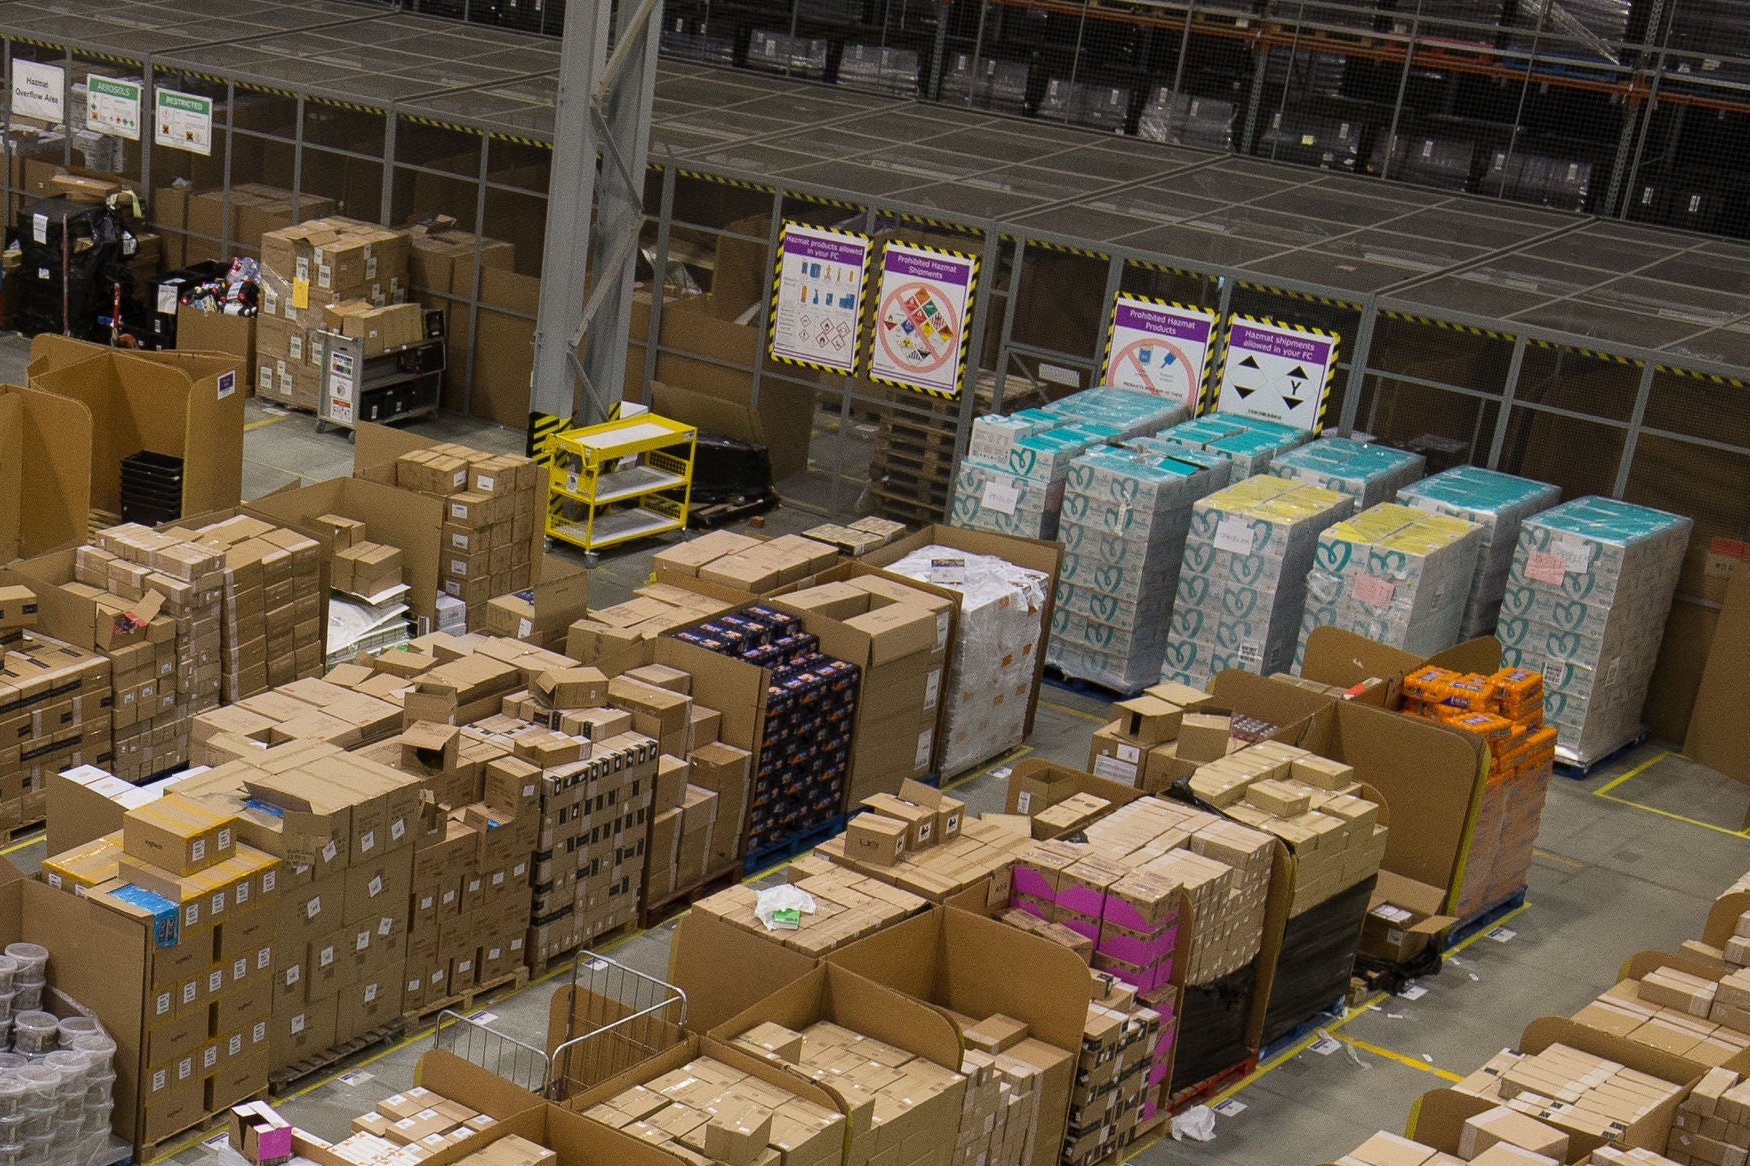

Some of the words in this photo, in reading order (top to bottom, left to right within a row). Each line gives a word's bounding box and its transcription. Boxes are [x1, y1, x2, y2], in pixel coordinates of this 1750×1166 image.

[26, 77, 49, 88] Hazmat
[97, 82, 131, 96] AEROSOLS
[15, 88, 43, 100] Overflow
[44, 95, 58, 104] Area
[166, 96, 203, 110] RESTRICTED
[786, 235, 809, 245] Hazmat
[810, 240, 838, 250] products
[839, 245, 863, 256] allowed
[815, 250, 829, 258] your
[898, 256, 930, 267] Prohibited
[932, 261, 956, 273] Hazmat
[909, 266, 943, 279] Shipments
[1130, 310, 1166, 324] Prohibited
[1167, 317, 1196, 330] Hazmat
[1145, 321, 1176, 335] Products
[1245, 330, 1274, 343] Hazmat
[1275, 337, 1315, 351] shipments
[1243, 340, 1272, 352] allowed
[1273, 346, 1282, 354] in
[1283, 349, 1300, 359] your
[1301, 351, 1313, 361] FC
[1290, 380, 1302, 395] Y
